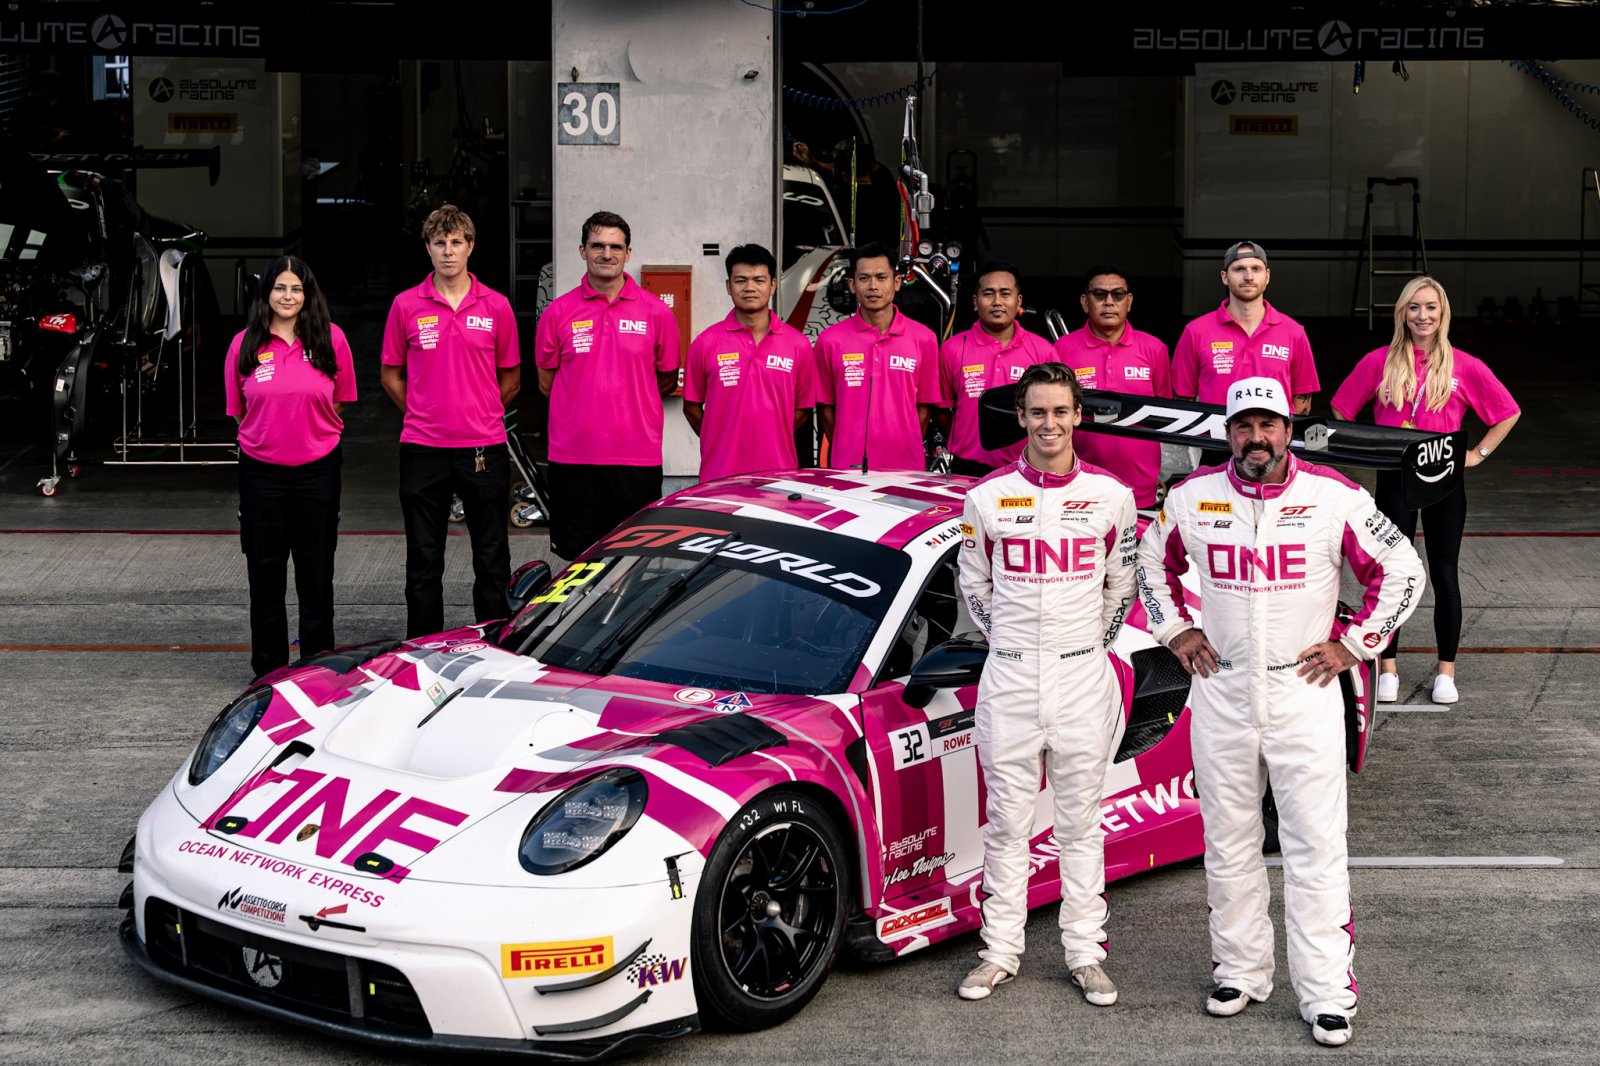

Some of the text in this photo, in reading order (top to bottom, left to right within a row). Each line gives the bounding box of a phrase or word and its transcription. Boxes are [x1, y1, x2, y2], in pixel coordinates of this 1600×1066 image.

[563, 92, 617, 136] 30
[466, 315, 493, 329] ONE
[619, 319, 647, 332] ONE
[1262, 344, 1289, 358] ONE
[766, 355, 794, 370] ONE
[889, 355, 917, 370] ONE
[1124, 367, 1150, 378] ONE
[1235, 387, 1273, 400] RACE
[1417, 435, 1453, 466] aws
[1001, 498, 1032, 507] PIRELLI
[1200, 502, 1230, 511] PIRELLI
[602, 525, 881, 598] GT WORLD
[1002, 538, 1096, 574] ONE
[1207, 544, 1306, 583] ONE
[530, 562, 606, 605] 32
[1003, 574, 1026, 583] OCEAN
[1066, 573, 1094, 581] EXPRESS
[1214, 582, 1232, 591] OCEAN
[1274, 582, 1306, 592] EXPRESS
[1379, 576, 1417, 638] seaspan
[898, 729, 924, 764] 32
[944, 733, 971, 752] ROWE
[792, 800, 805, 815] FL
[198, 766, 471, 885] ONE
[178, 840, 386, 909] OCEAN NETWORK EXPRESS
[240, 904, 286, 923] COMPETIZIONE
[882, 903, 949, 934] DIXCEL
[511, 944, 605, 971] PIRELLI
[638, 956, 688, 989] KW
